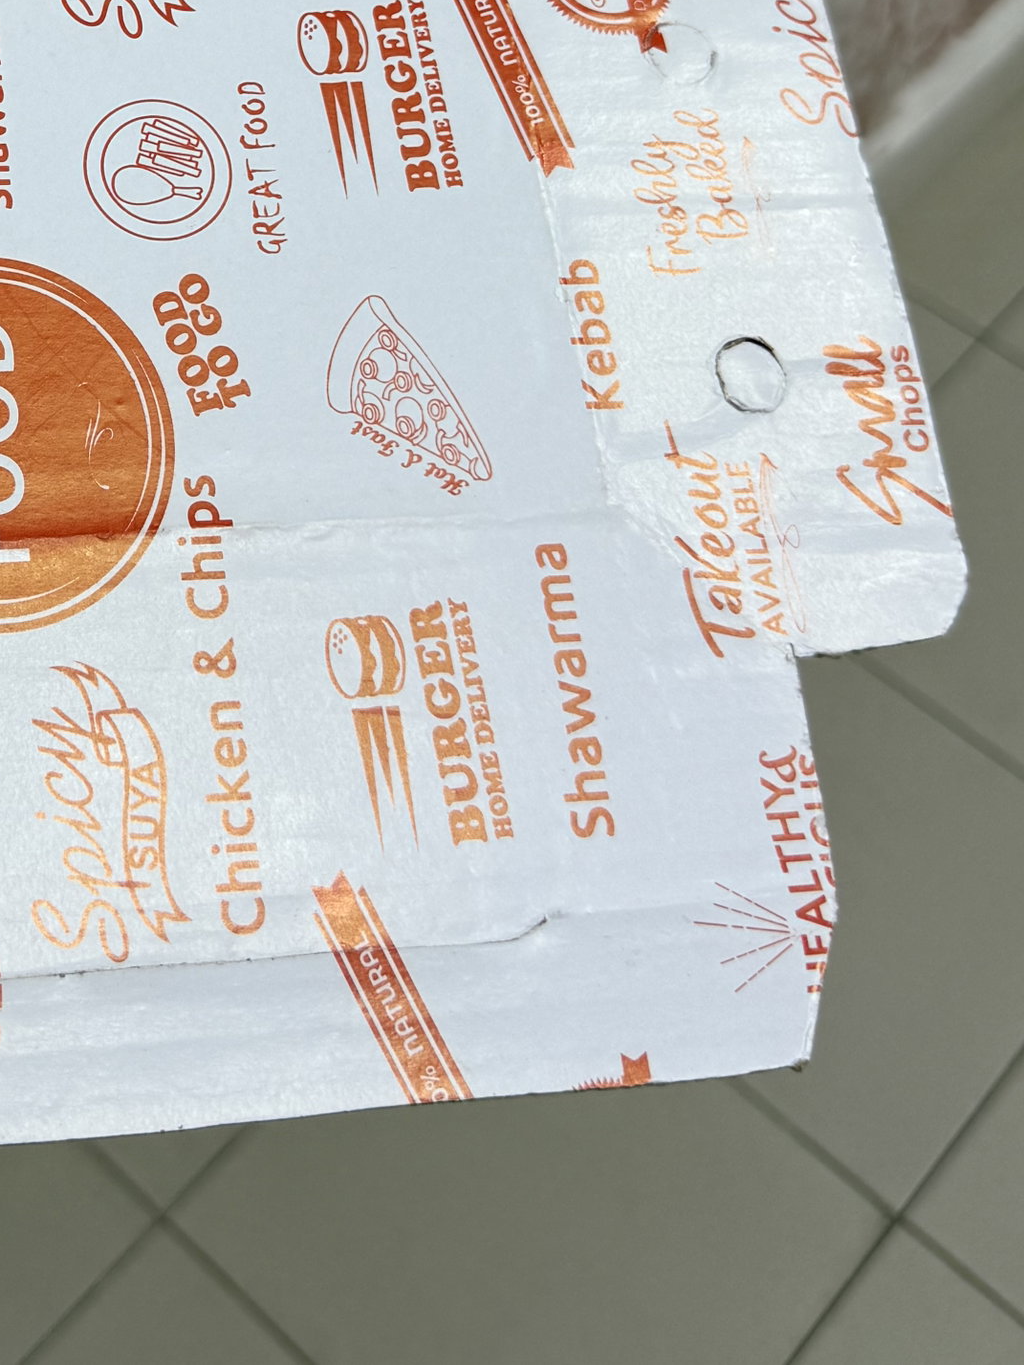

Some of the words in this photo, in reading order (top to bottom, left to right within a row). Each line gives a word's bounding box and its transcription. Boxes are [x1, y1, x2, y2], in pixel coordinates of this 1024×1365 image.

[236, 80, 275, 150] FOOD
[433, 117, 465, 190] HOME
[508, 68, 546, 127] 100%
[246, 158, 288, 256] GREAT
[631, 131, 702, 277] Freshly
[674, 107, 749, 242] Baked
[152, 289, 224, 417] FOOD
[177, 273, 223, 337] GO
[559, 256, 625, 412] Kebab
[207, 345, 252, 409] TO
[821, 334, 954, 526] Small
[887, 343, 930, 454] Chops
[180, 474, 234, 621] Chips
[723, 458, 787, 636] AVAILABLE
[193, 637, 238, 680] &
[408, 599, 488, 847] BURGER
[447, 596, 494, 746] DELIVERY
[534, 541, 615, 839] Shawarma
[30, 706, 130, 963] Spicy
[122, 759, 164, 872] SUYA
[204, 700, 266, 936] Chicken
[479, 750, 515, 840] HOME
